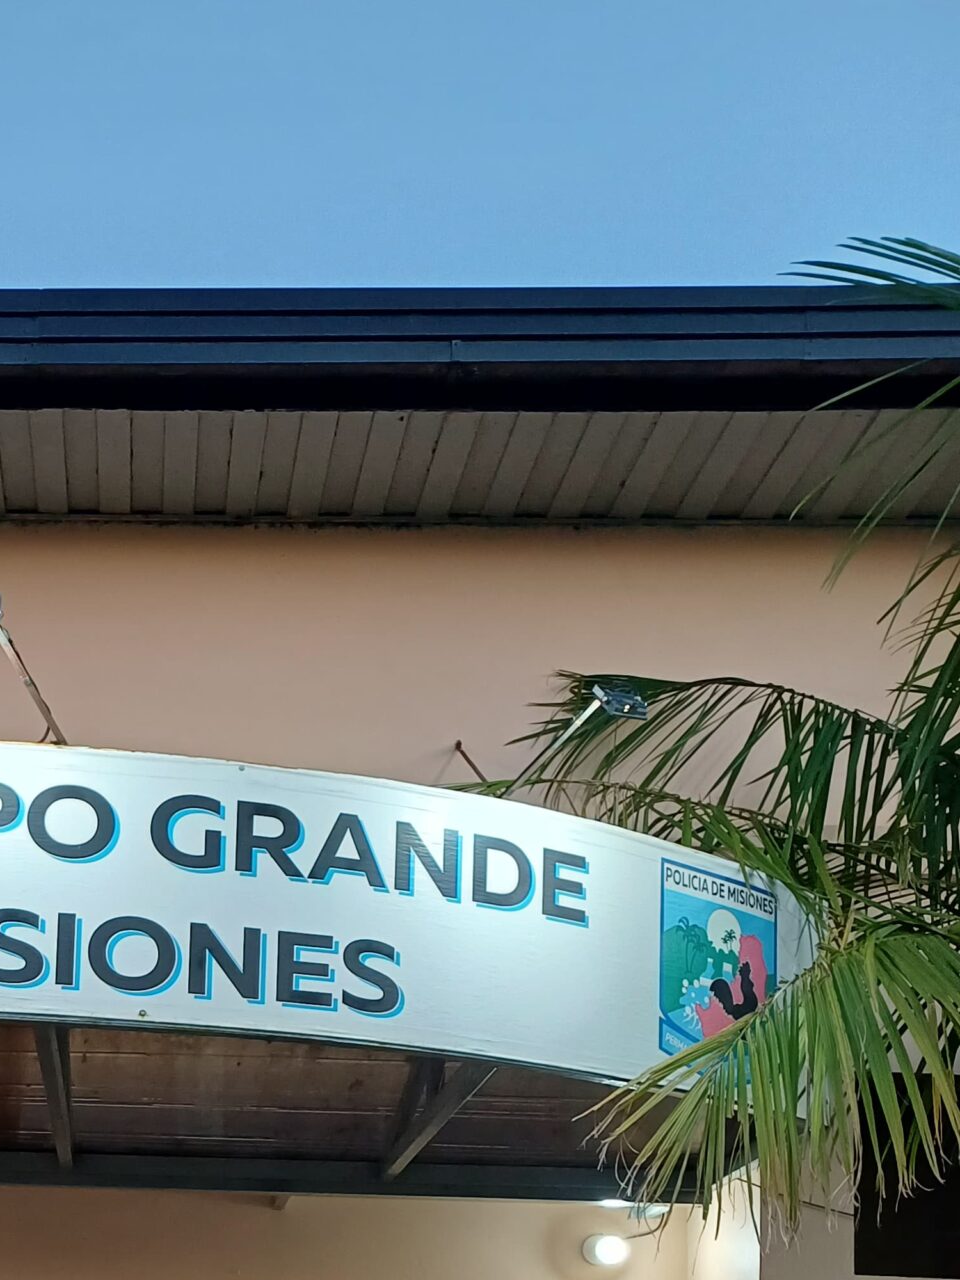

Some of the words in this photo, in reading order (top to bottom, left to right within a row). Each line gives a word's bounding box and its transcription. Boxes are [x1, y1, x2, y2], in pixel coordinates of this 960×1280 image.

[149, 793, 590, 928] GRANDE
[665, 866, 709, 896] POLICIA
[711, 881, 725, 899] DE
[727, 886, 774, 916] MISIONES
